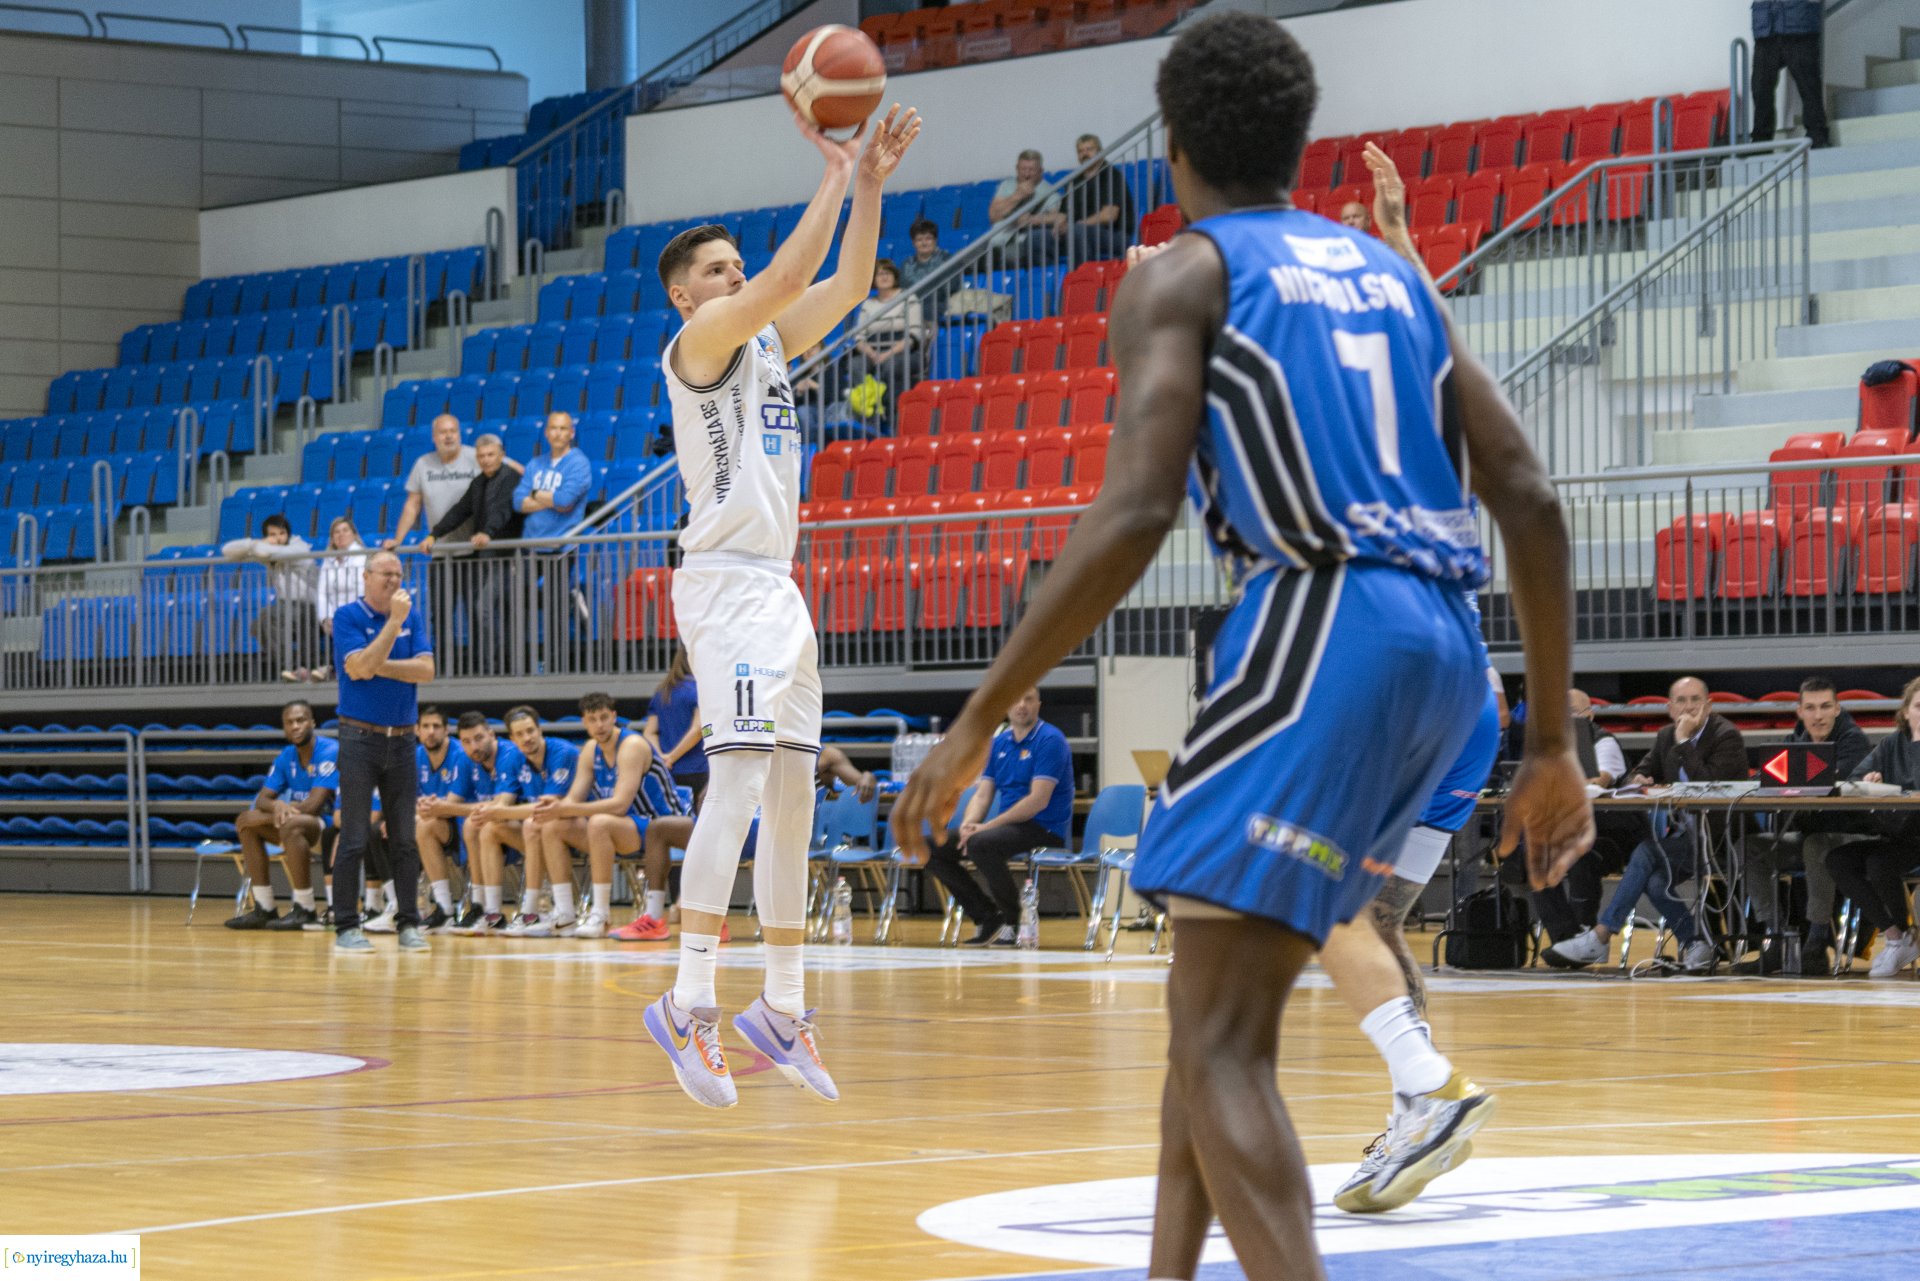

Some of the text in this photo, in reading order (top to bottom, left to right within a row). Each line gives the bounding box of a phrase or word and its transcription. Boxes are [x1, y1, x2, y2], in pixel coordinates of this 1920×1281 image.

[701, 400, 719, 420] BS
[1333, 328, 1402, 476] 7
[533, 469, 563, 492] GAP
[734, 680, 753, 716] 11
